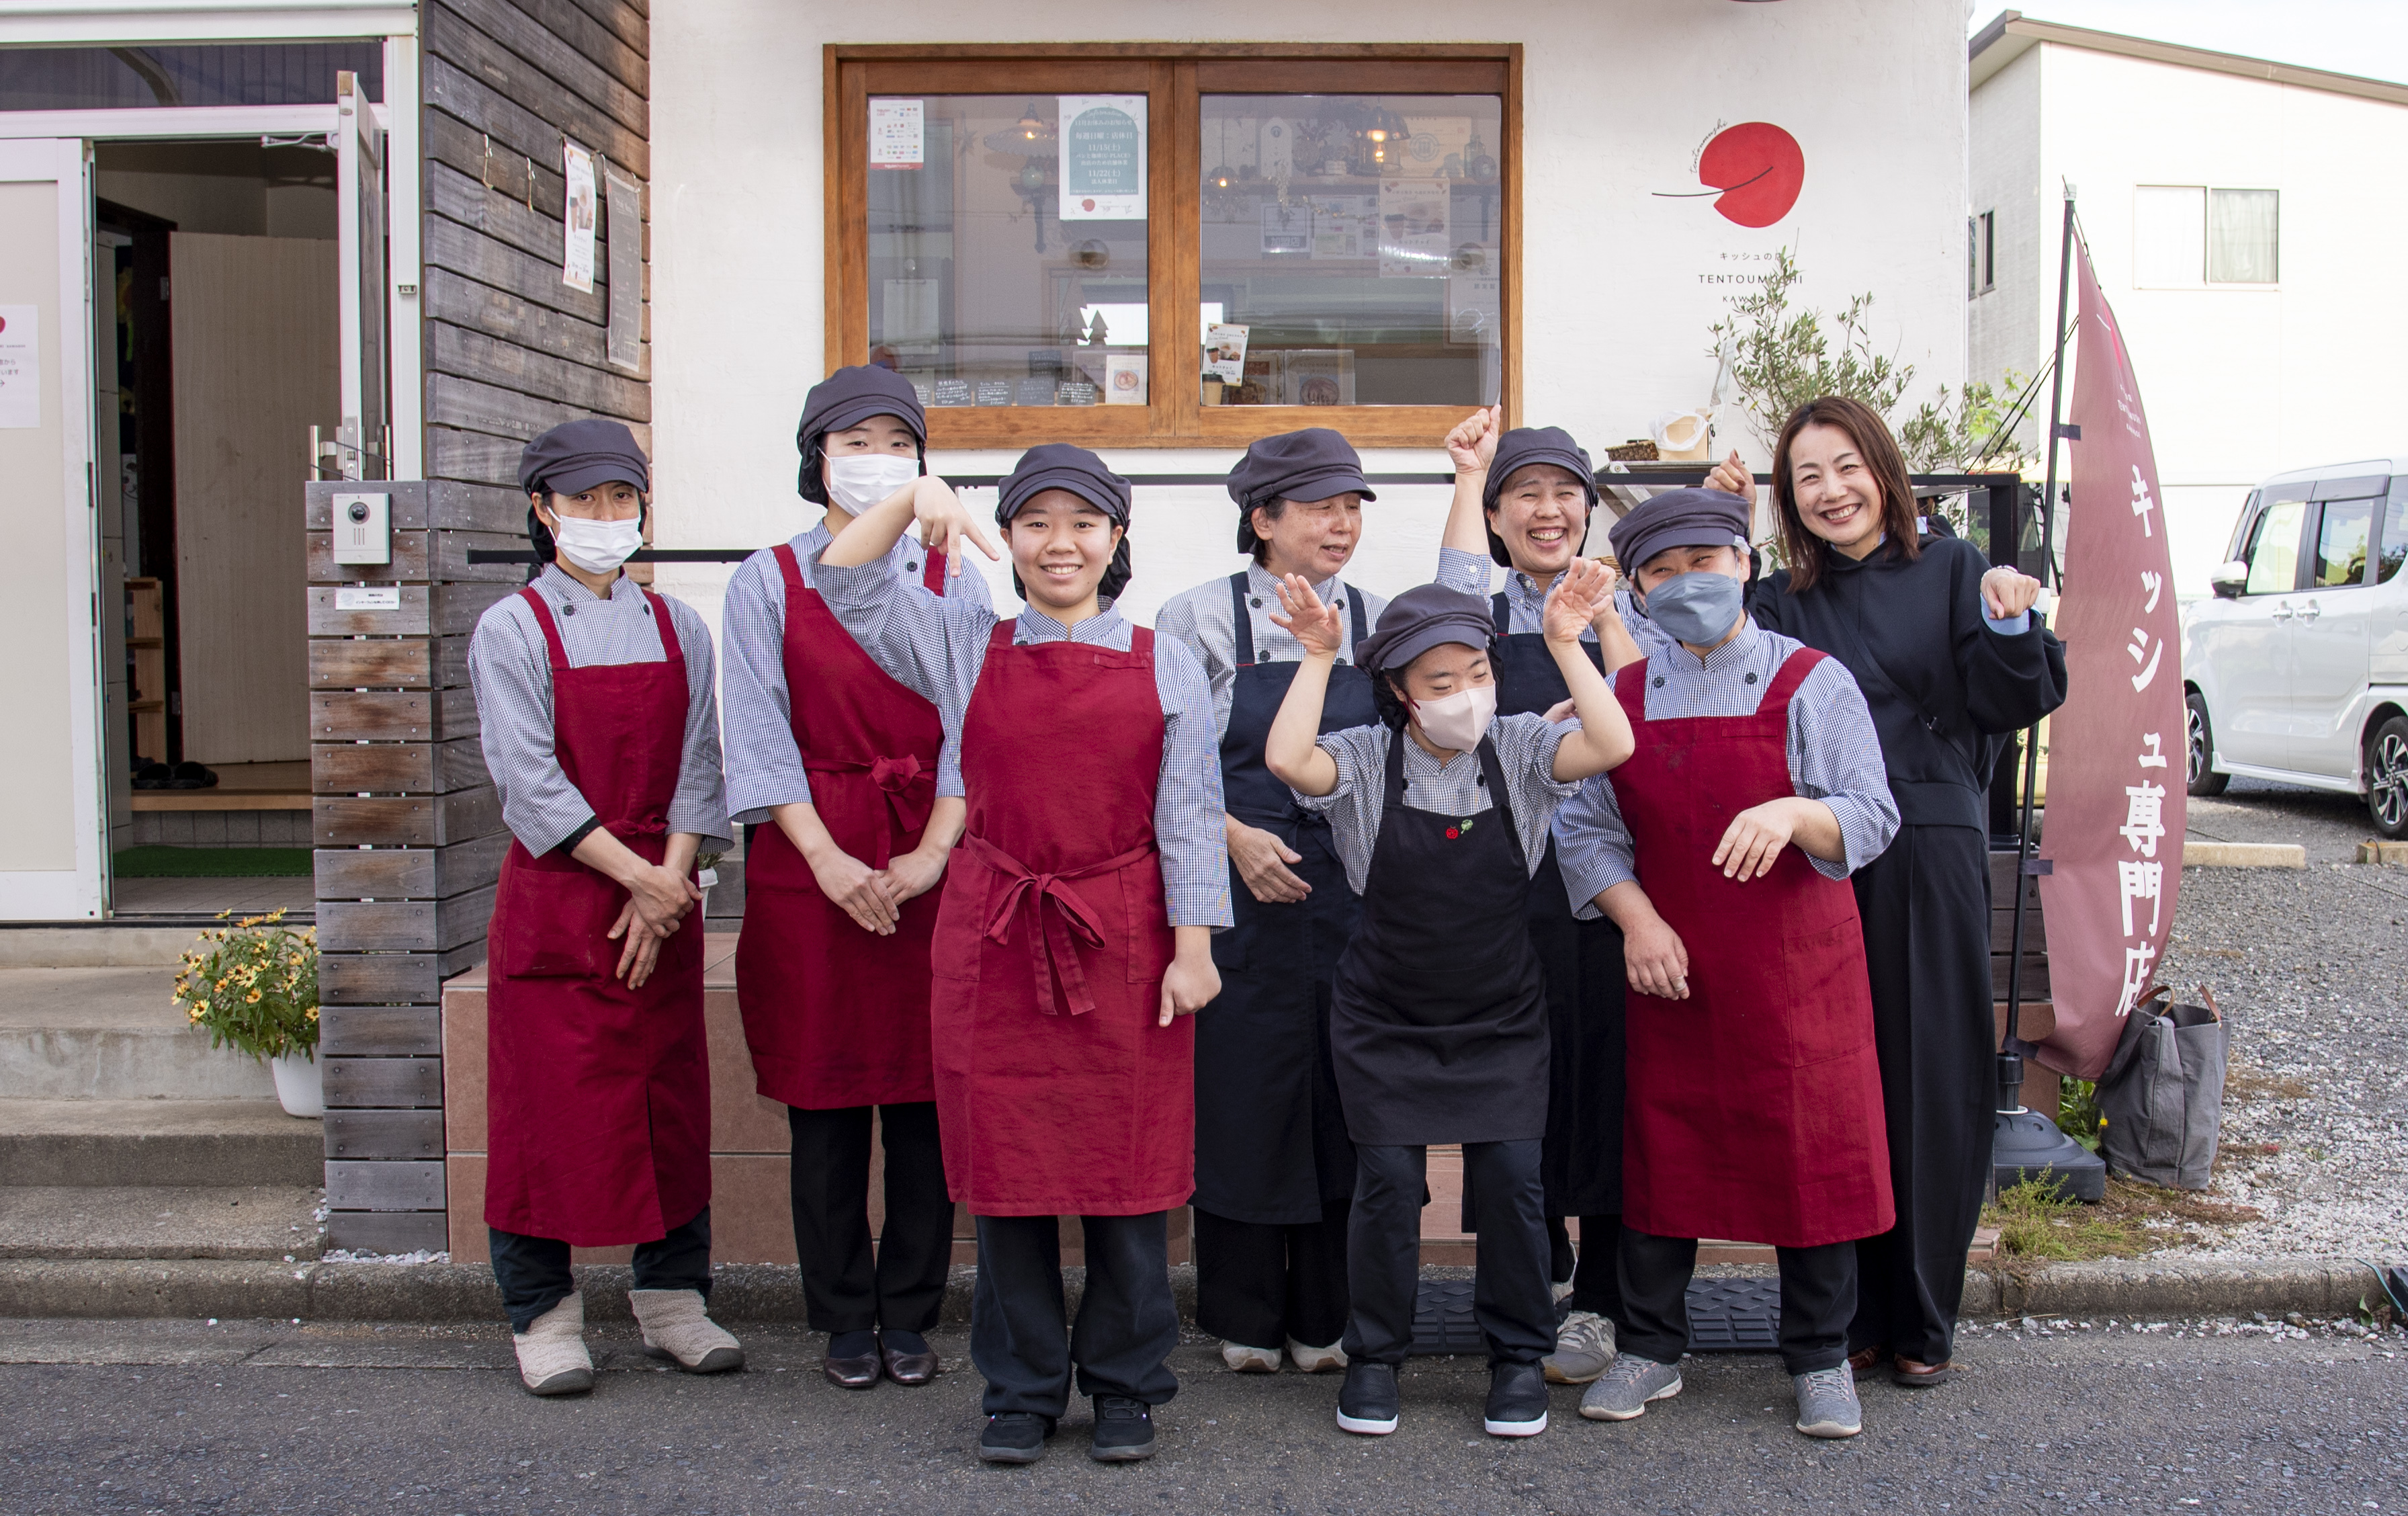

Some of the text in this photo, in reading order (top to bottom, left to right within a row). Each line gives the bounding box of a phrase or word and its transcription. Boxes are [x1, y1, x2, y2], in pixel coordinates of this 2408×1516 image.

[1698, 274, 1803, 284] TENTOUMUHI
[2115, 464, 2168, 1017] キッシュ専門店
